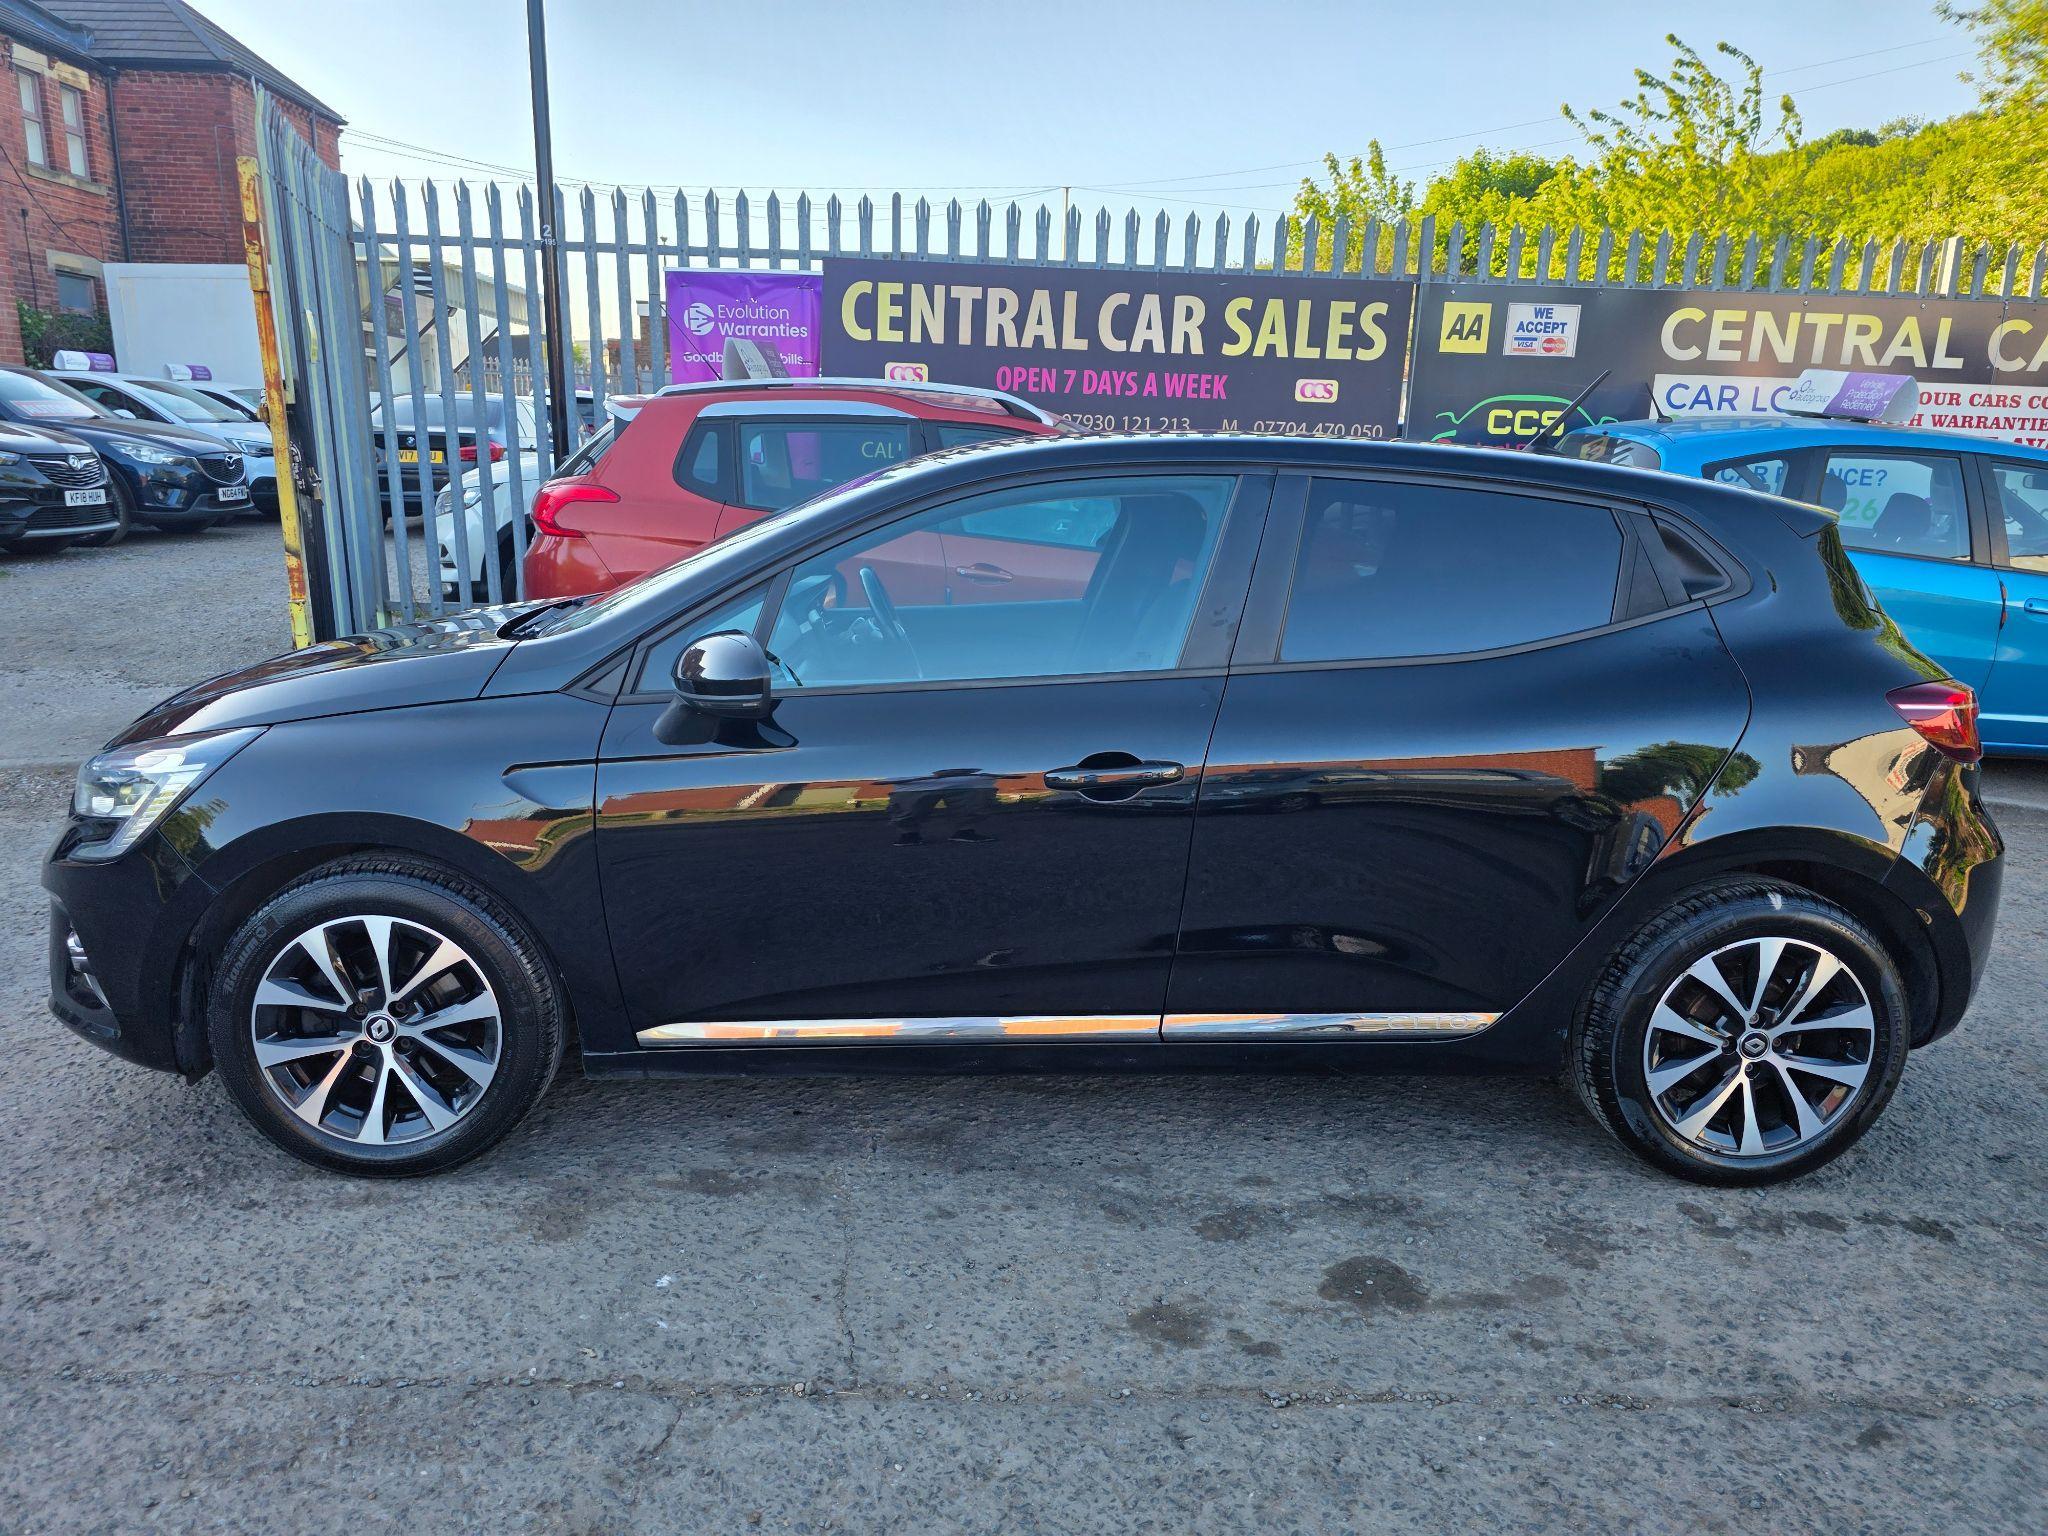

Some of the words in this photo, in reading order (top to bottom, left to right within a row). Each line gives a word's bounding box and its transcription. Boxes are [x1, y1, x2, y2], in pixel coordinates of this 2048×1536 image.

[542, 224, 552, 237] 2
[718, 304, 790, 320] Evolution
[841, 280, 1088, 351] CENTRAL
[1097, 292, 1206, 355] CAR
[1221, 296, 1389, 361] SALES
[1534, 307, 1554, 319] WE
[718, 322, 808, 338] Warranties
[1446, 313, 1484, 341] AA
[1516, 321, 1568, 334] ACCEPT
[1660, 307, 1965, 370] CENTRAL
[996, 366, 1056, 393] OPEN
[1063, 370, 1077, 394] 7
[1082, 371, 1138, 397] DAYS
[1142, 374, 1159, 397] A
[1164, 374, 1229, 400] WEEK
[1300, 383, 1334, 399] CCS
[1665, 382, 1740, 412] CAR
[1919, 391, 1962, 407] OUR
[1968, 393, 2022, 409] CARS
[1122, 416, 1151, 430] 121
[1159, 417, 1190, 430] 213
[1222, 419, 1238, 431] M
[1312, 422, 1345, 436] 470
[1487, 408, 1565, 437] CCS
[1721, 466, 1769, 483] CR
